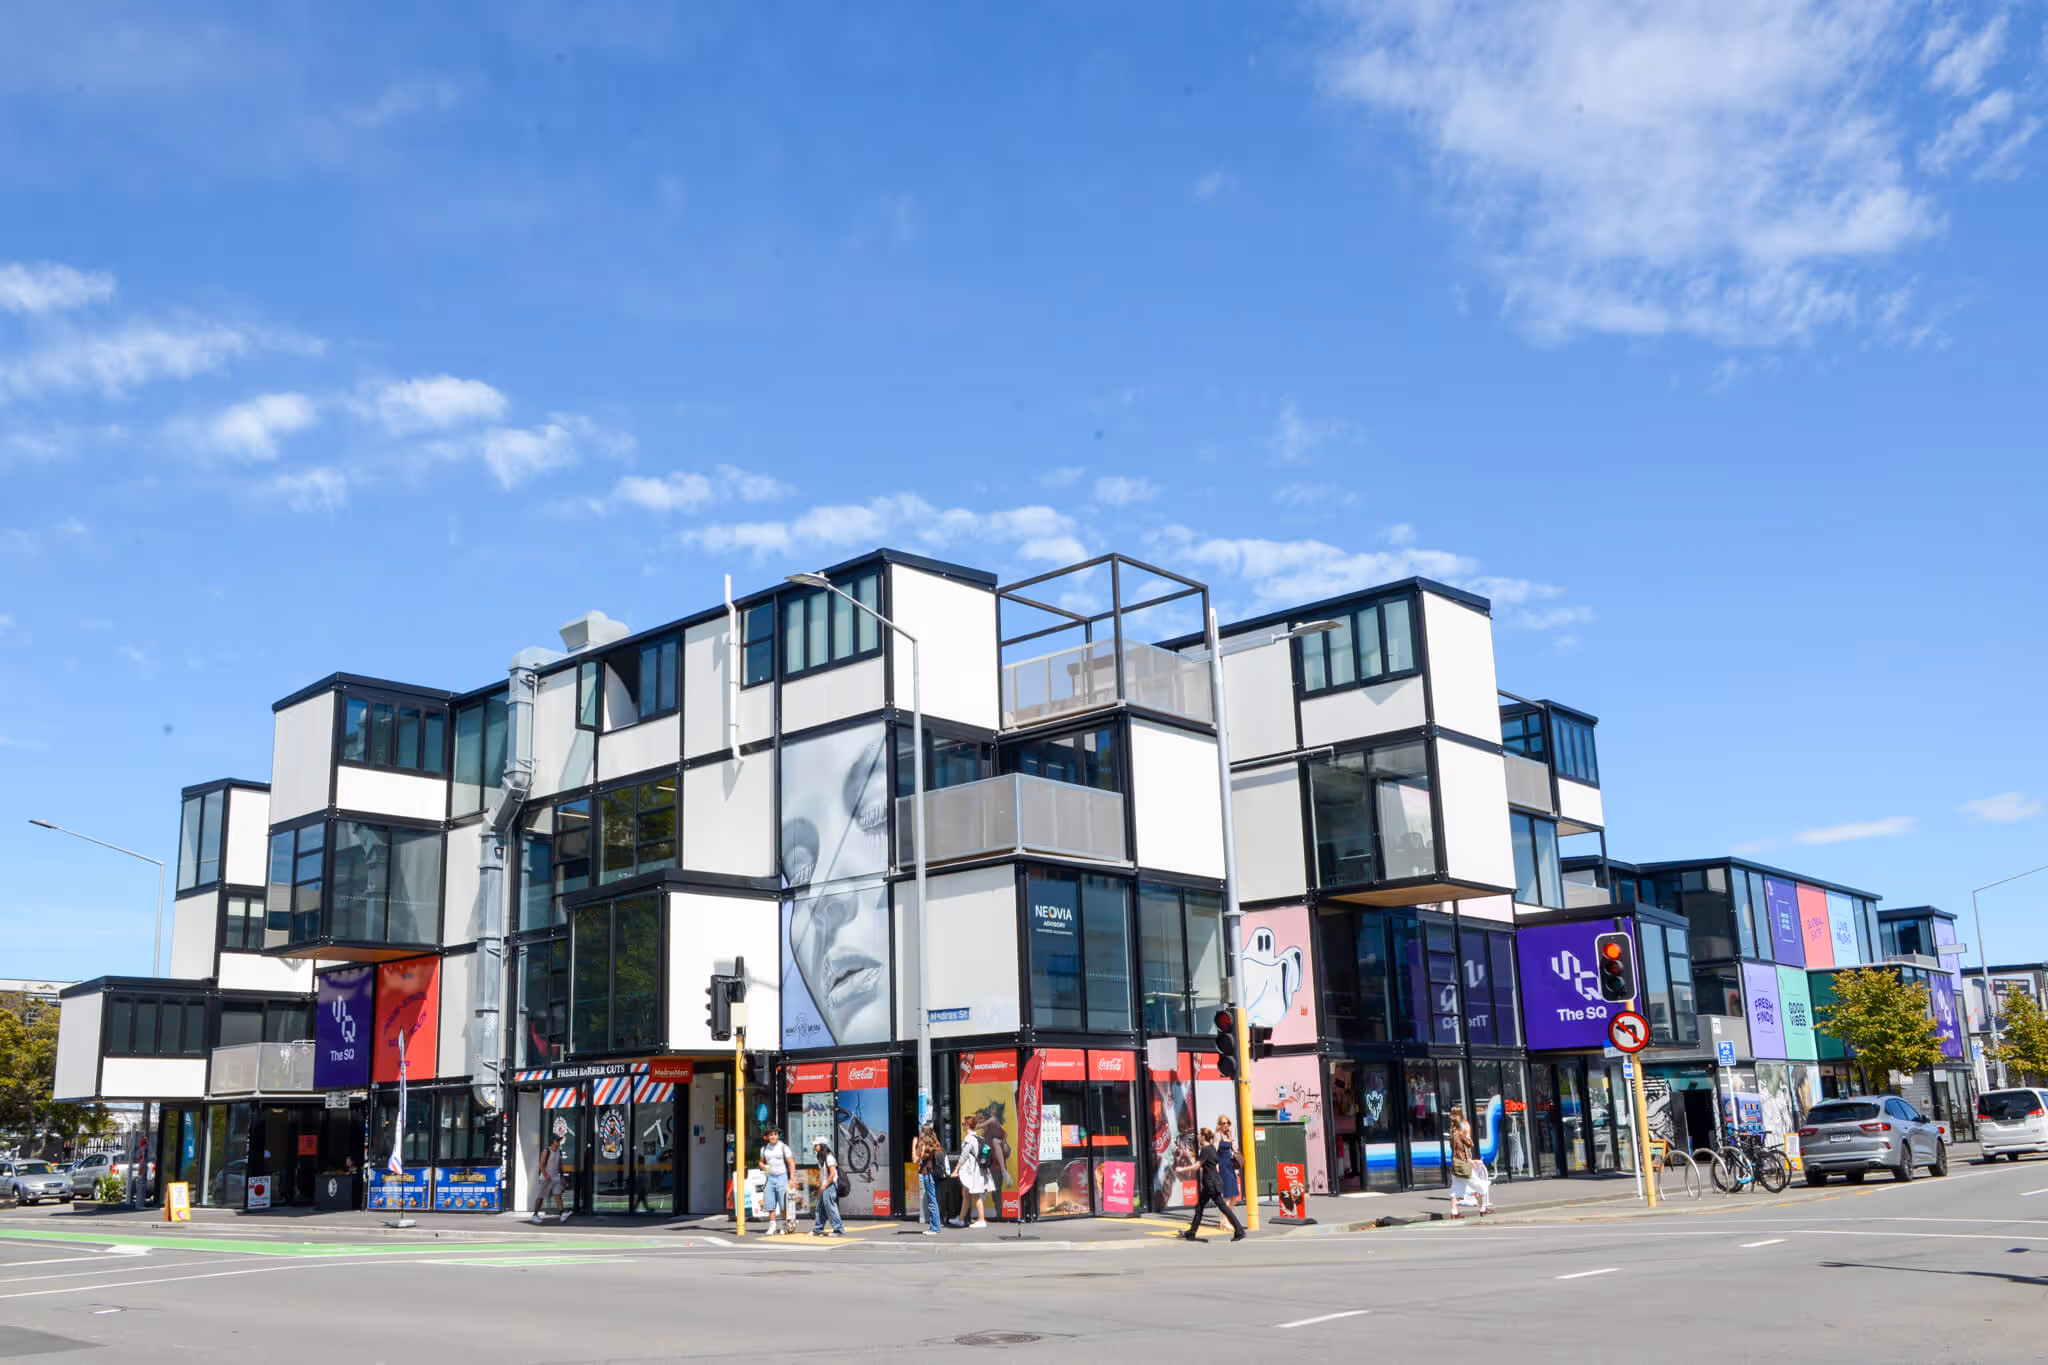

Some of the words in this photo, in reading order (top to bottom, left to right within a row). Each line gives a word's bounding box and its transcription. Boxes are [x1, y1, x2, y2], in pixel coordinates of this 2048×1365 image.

[1035, 904, 1073, 921] NEOVIA
[1043, 920, 1066, 929] ADVISORY
[1754, 997, 1773, 1012] FRESH
[1788, 1002, 1804, 1014] GOOD
[930, 1012, 957, 1021] Madras
[1557, 1008, 1584, 1022] The
[1586, 1006, 1607, 1019] SQ
[1756, 1011, 1774, 1025] FINDS
[1789, 1014, 1806, 1027] VIBES
[330, 1050, 344, 1062] The
[344, 1048, 355, 1061] SQ
[557, 1068, 578, 1078] FRESH
[579, 1065, 605, 1077] BARBER
[606, 1064, 625, 1074] CUTS
[1098, 1057, 1123, 1071] Coca-Cola
[849, 1066, 875, 1081] Coca-Cola
[1022, 1081, 1040, 1171] Coca-Cola
